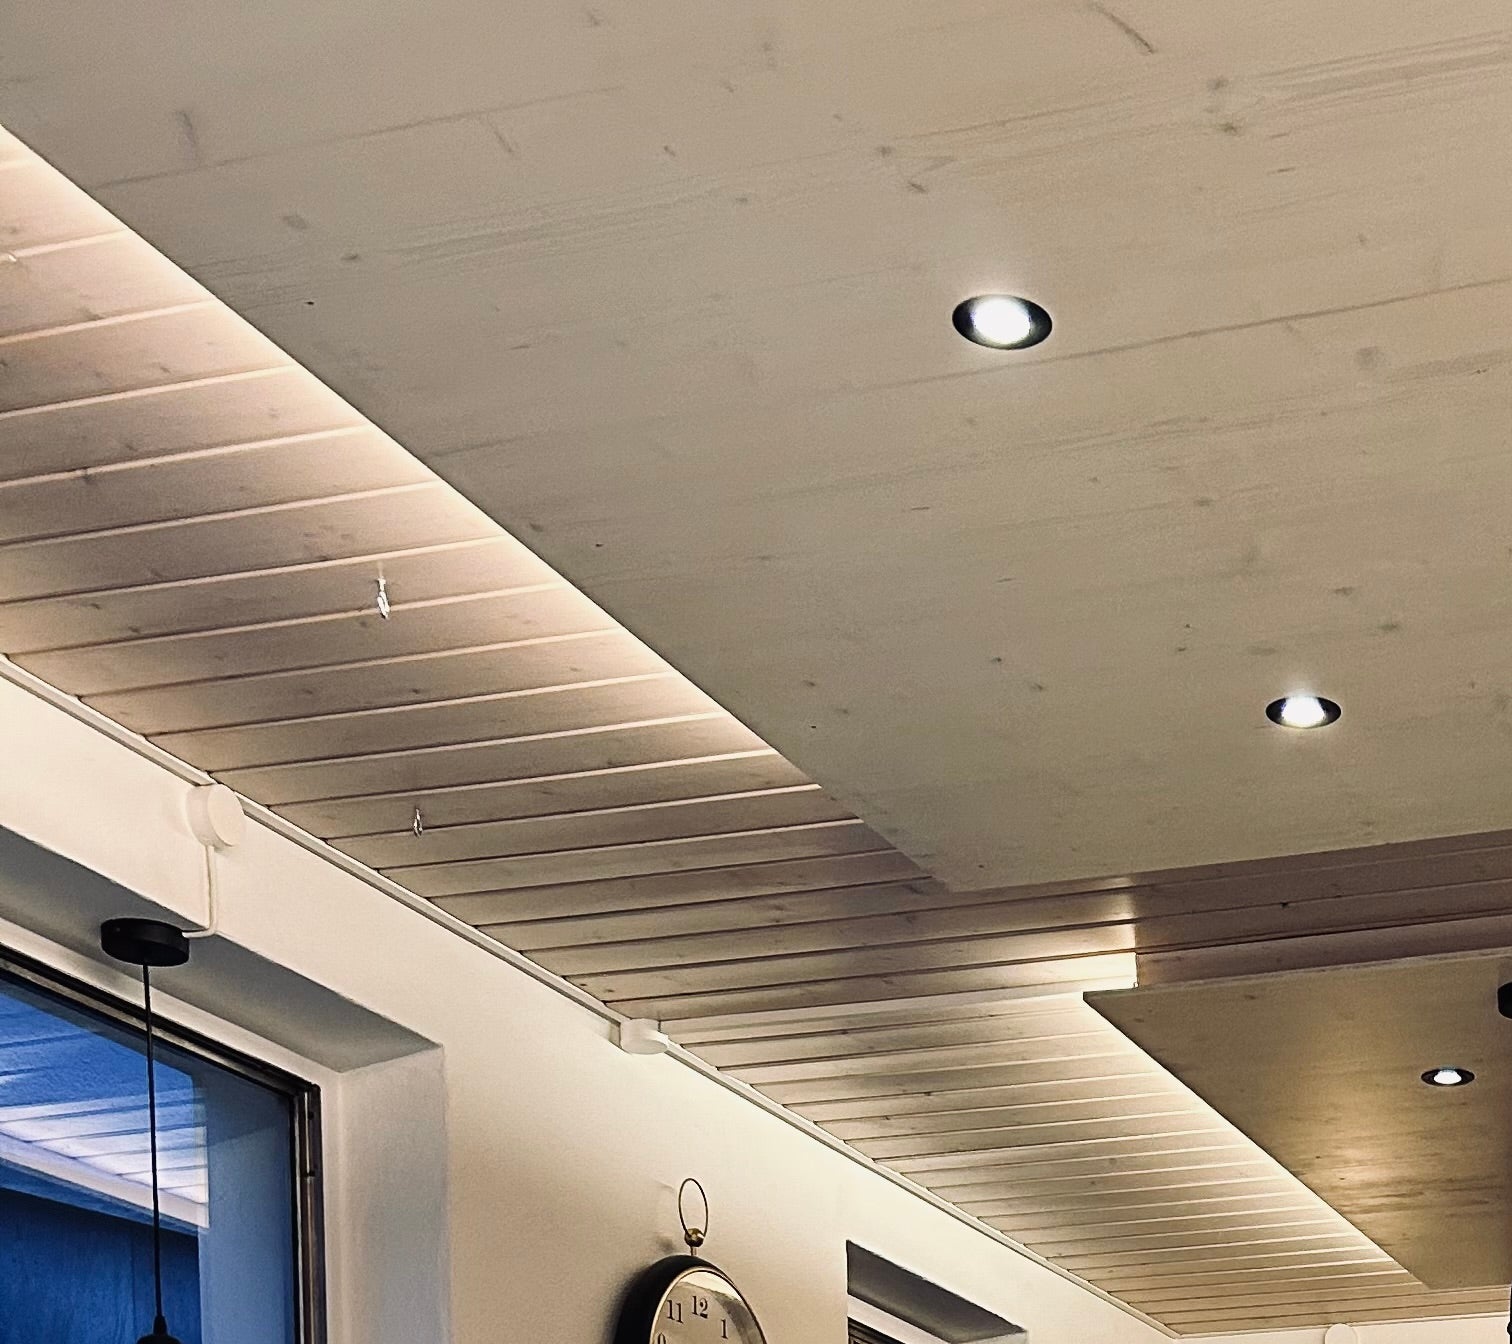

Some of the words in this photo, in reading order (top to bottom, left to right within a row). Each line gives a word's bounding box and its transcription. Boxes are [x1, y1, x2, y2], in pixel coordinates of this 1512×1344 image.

[666, 1299, 684, 1324] 11
[692, 1296, 709, 1319] 12
[720, 1318, 729, 1340] 1
